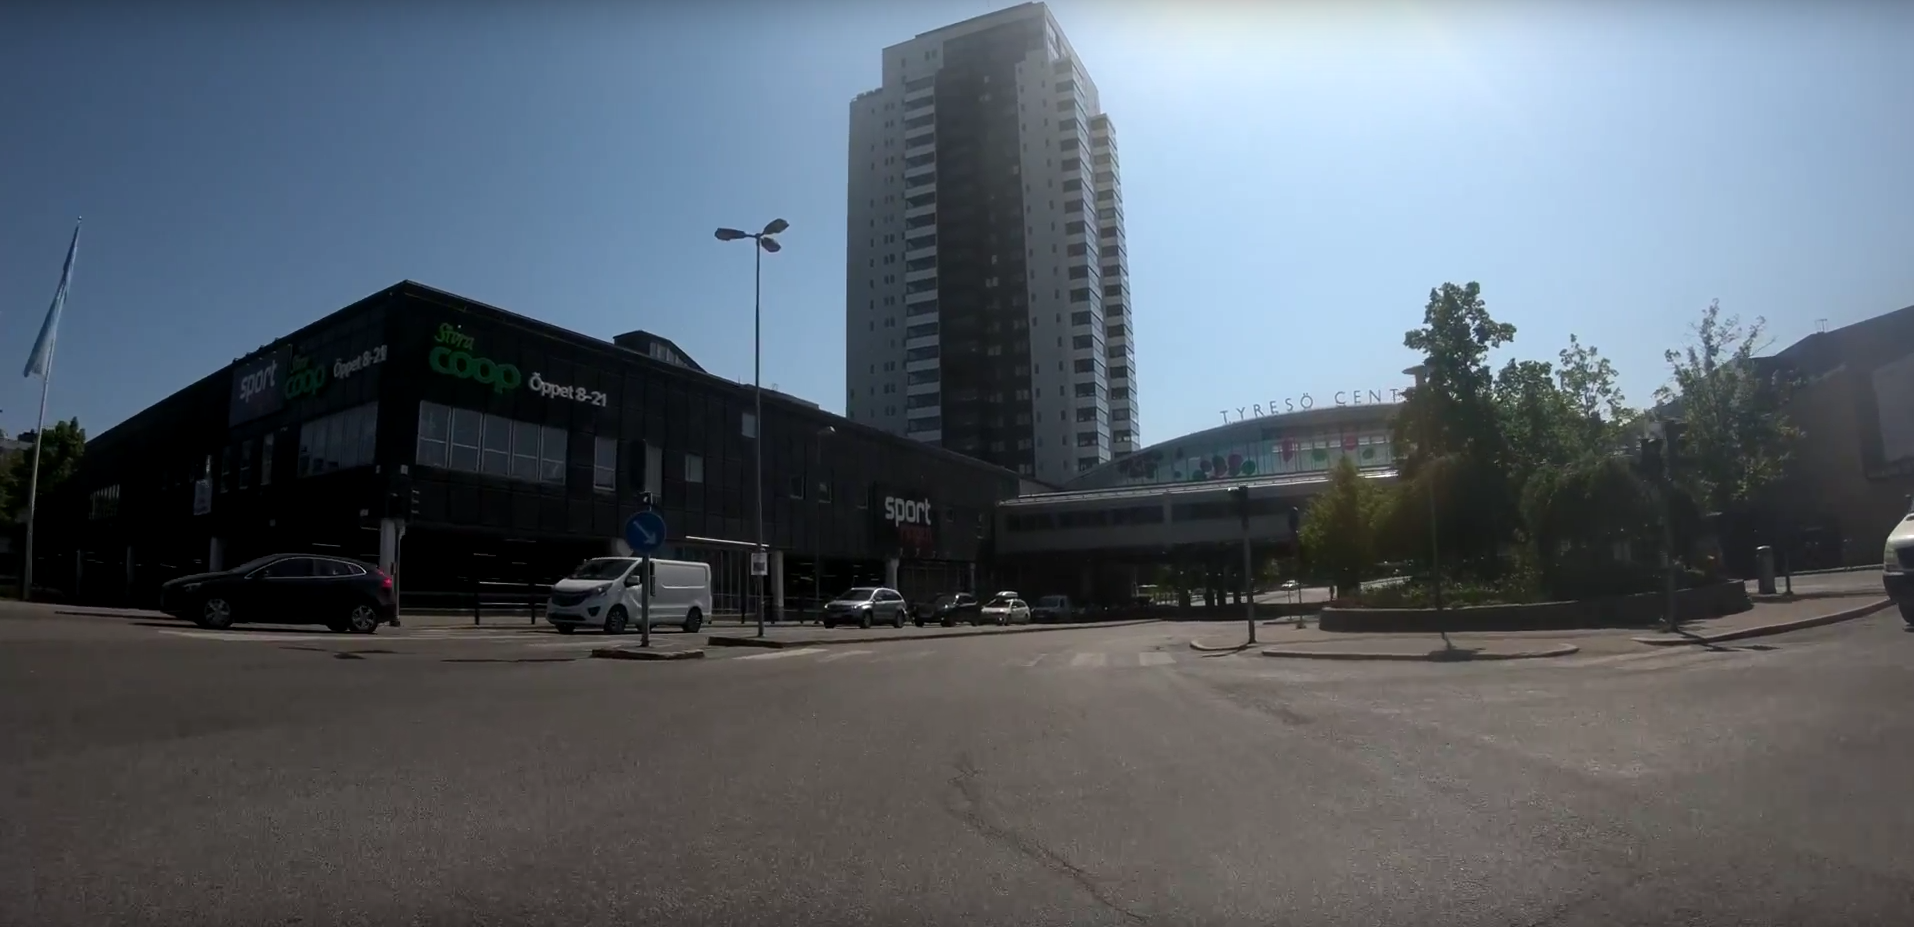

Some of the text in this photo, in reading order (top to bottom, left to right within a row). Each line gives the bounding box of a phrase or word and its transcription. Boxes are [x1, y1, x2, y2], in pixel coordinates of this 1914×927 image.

[434, 322, 475, 350] Stora
[333, 344, 388, 379] Öppet 8-21
[428, 346, 522, 394] coop
[239, 359, 278, 403] sport
[285, 364, 326, 399] coop
[528, 371, 607, 407] Öppet 8-21
[1220, 388, 1400, 424] TYRESÖ CENT
[884, 496, 931, 527] sport
